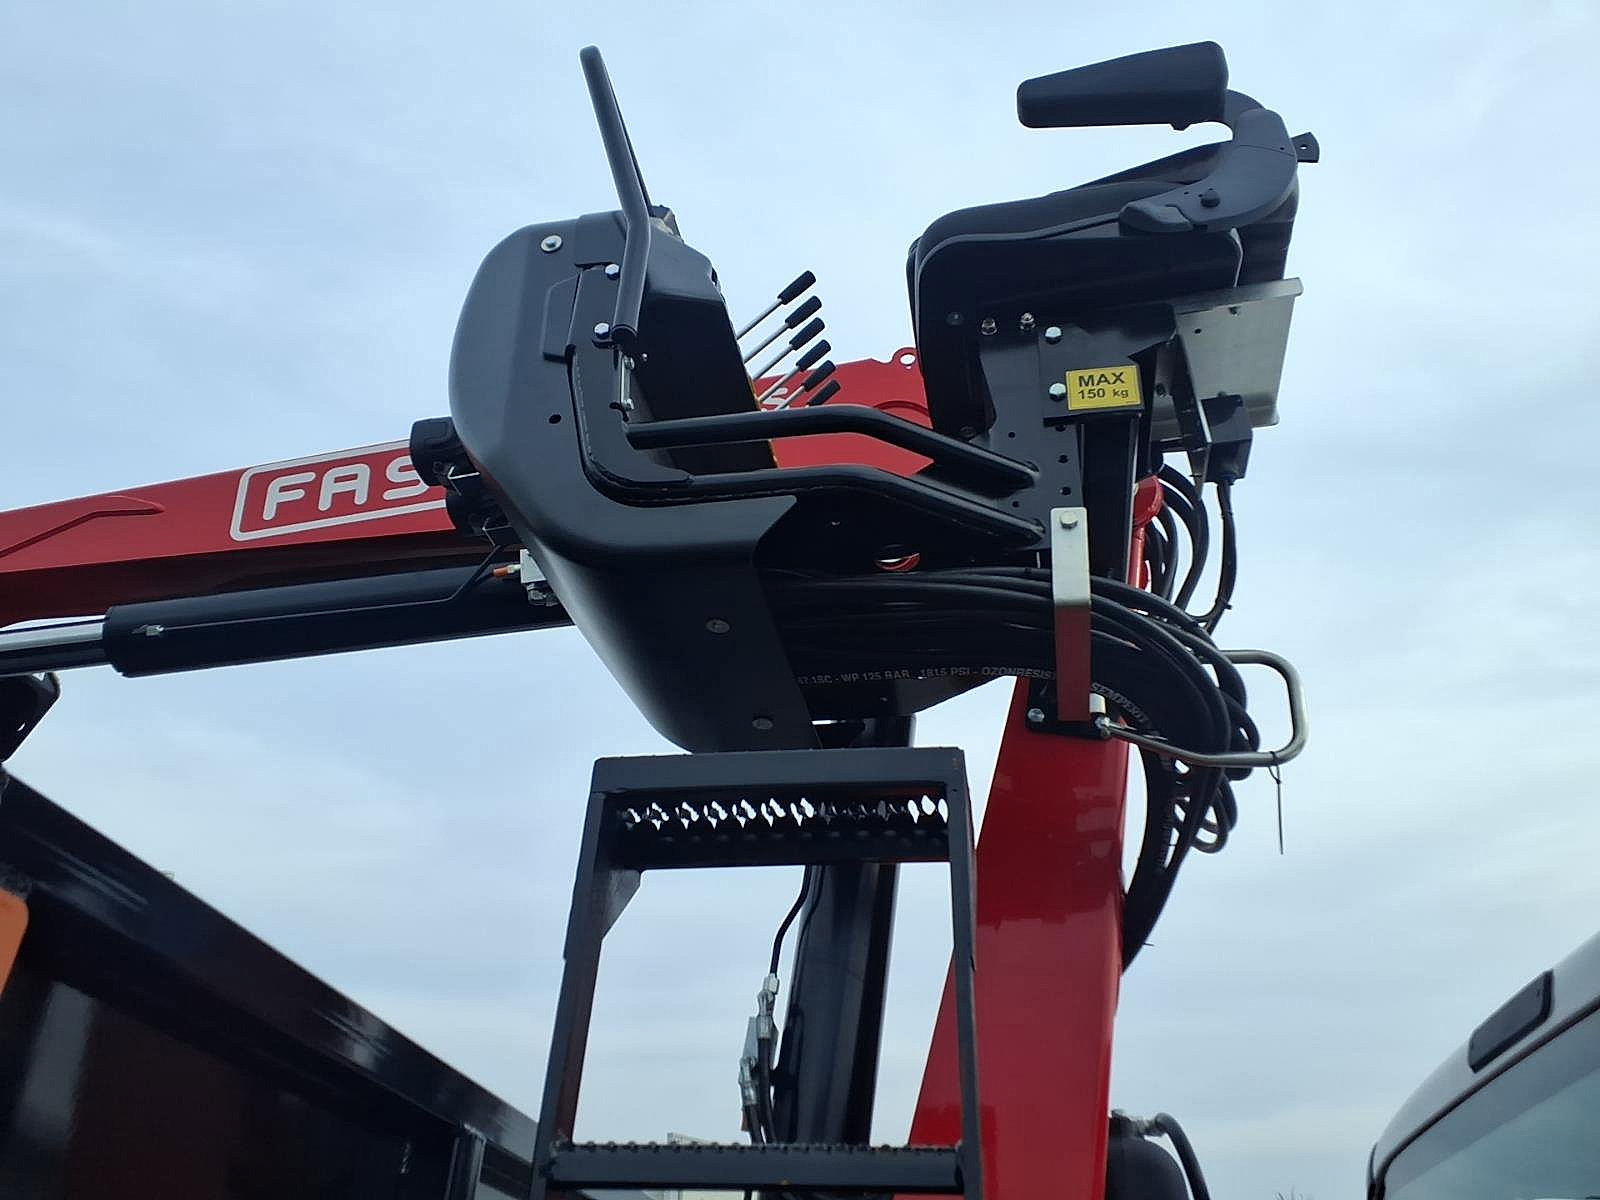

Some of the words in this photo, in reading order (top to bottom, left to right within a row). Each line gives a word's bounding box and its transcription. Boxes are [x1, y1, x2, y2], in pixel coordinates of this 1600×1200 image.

[1078, 371, 1125, 388] MAX
[1078, 388, 1106, 400] 150
[1112, 388, 1129, 398] kg
[263, 457, 430, 519] FAS
[862, 671, 882, 681] 125
[884, 669, 911, 681] BAR
[949, 666, 970, 677] PSI
